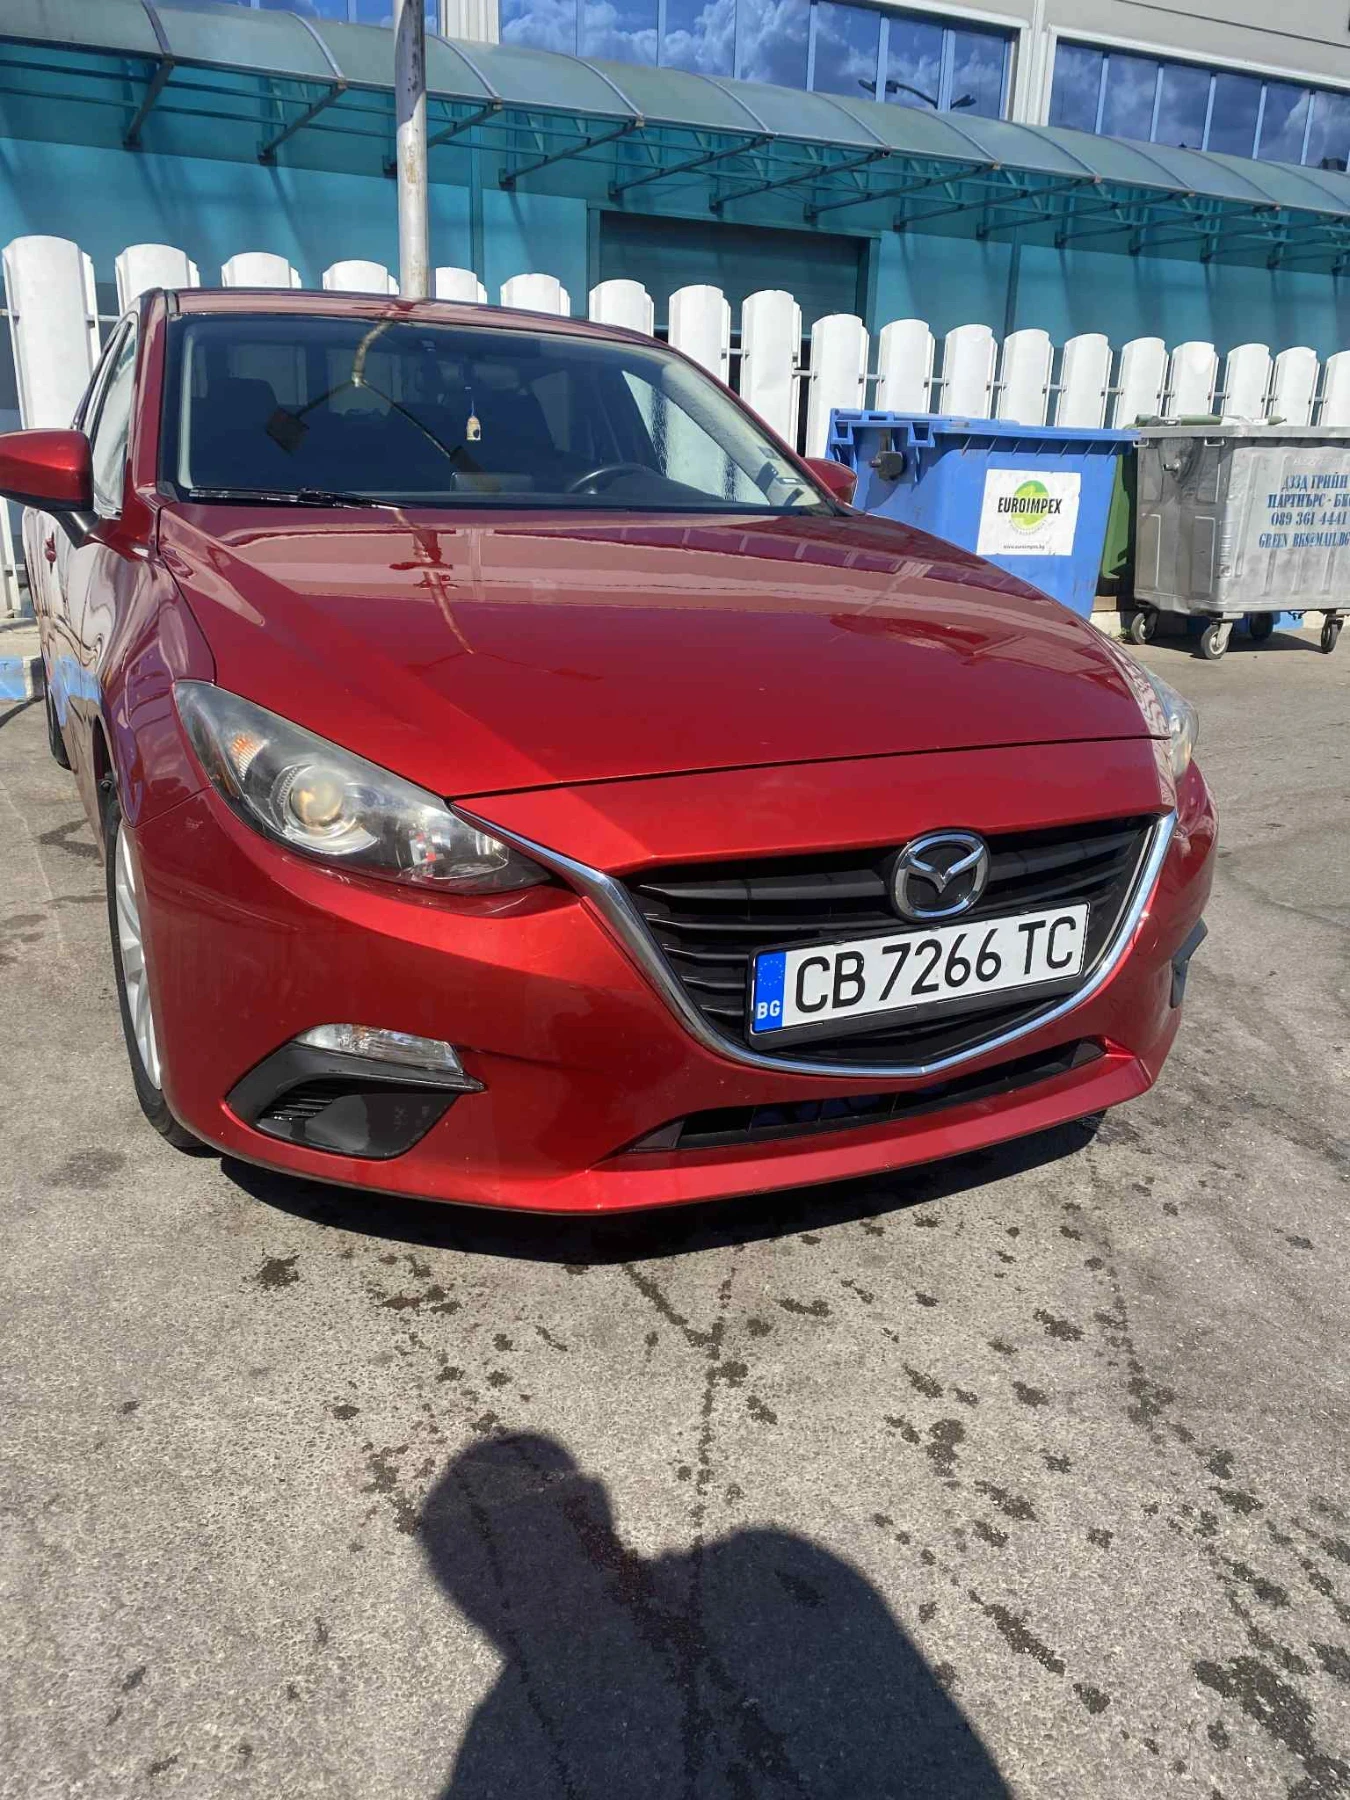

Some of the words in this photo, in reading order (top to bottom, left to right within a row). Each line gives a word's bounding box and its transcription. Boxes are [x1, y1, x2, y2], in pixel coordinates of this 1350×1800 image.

[997, 497, 1063, 514] EUROIMPEX
[1267, 493, 1326, 508] ПАРТНЪРС
[1271, 512, 1293, 526] 089
[1296, 511, 1316, 526] 361
[1259, 532, 1288, 548] GREEN
[795, 950, 866, 1014] CB
[878, 928, 1002, 1002] 7266
[1017, 915, 1077, 976] TC
[757, 1000, 781, 1019] BG
